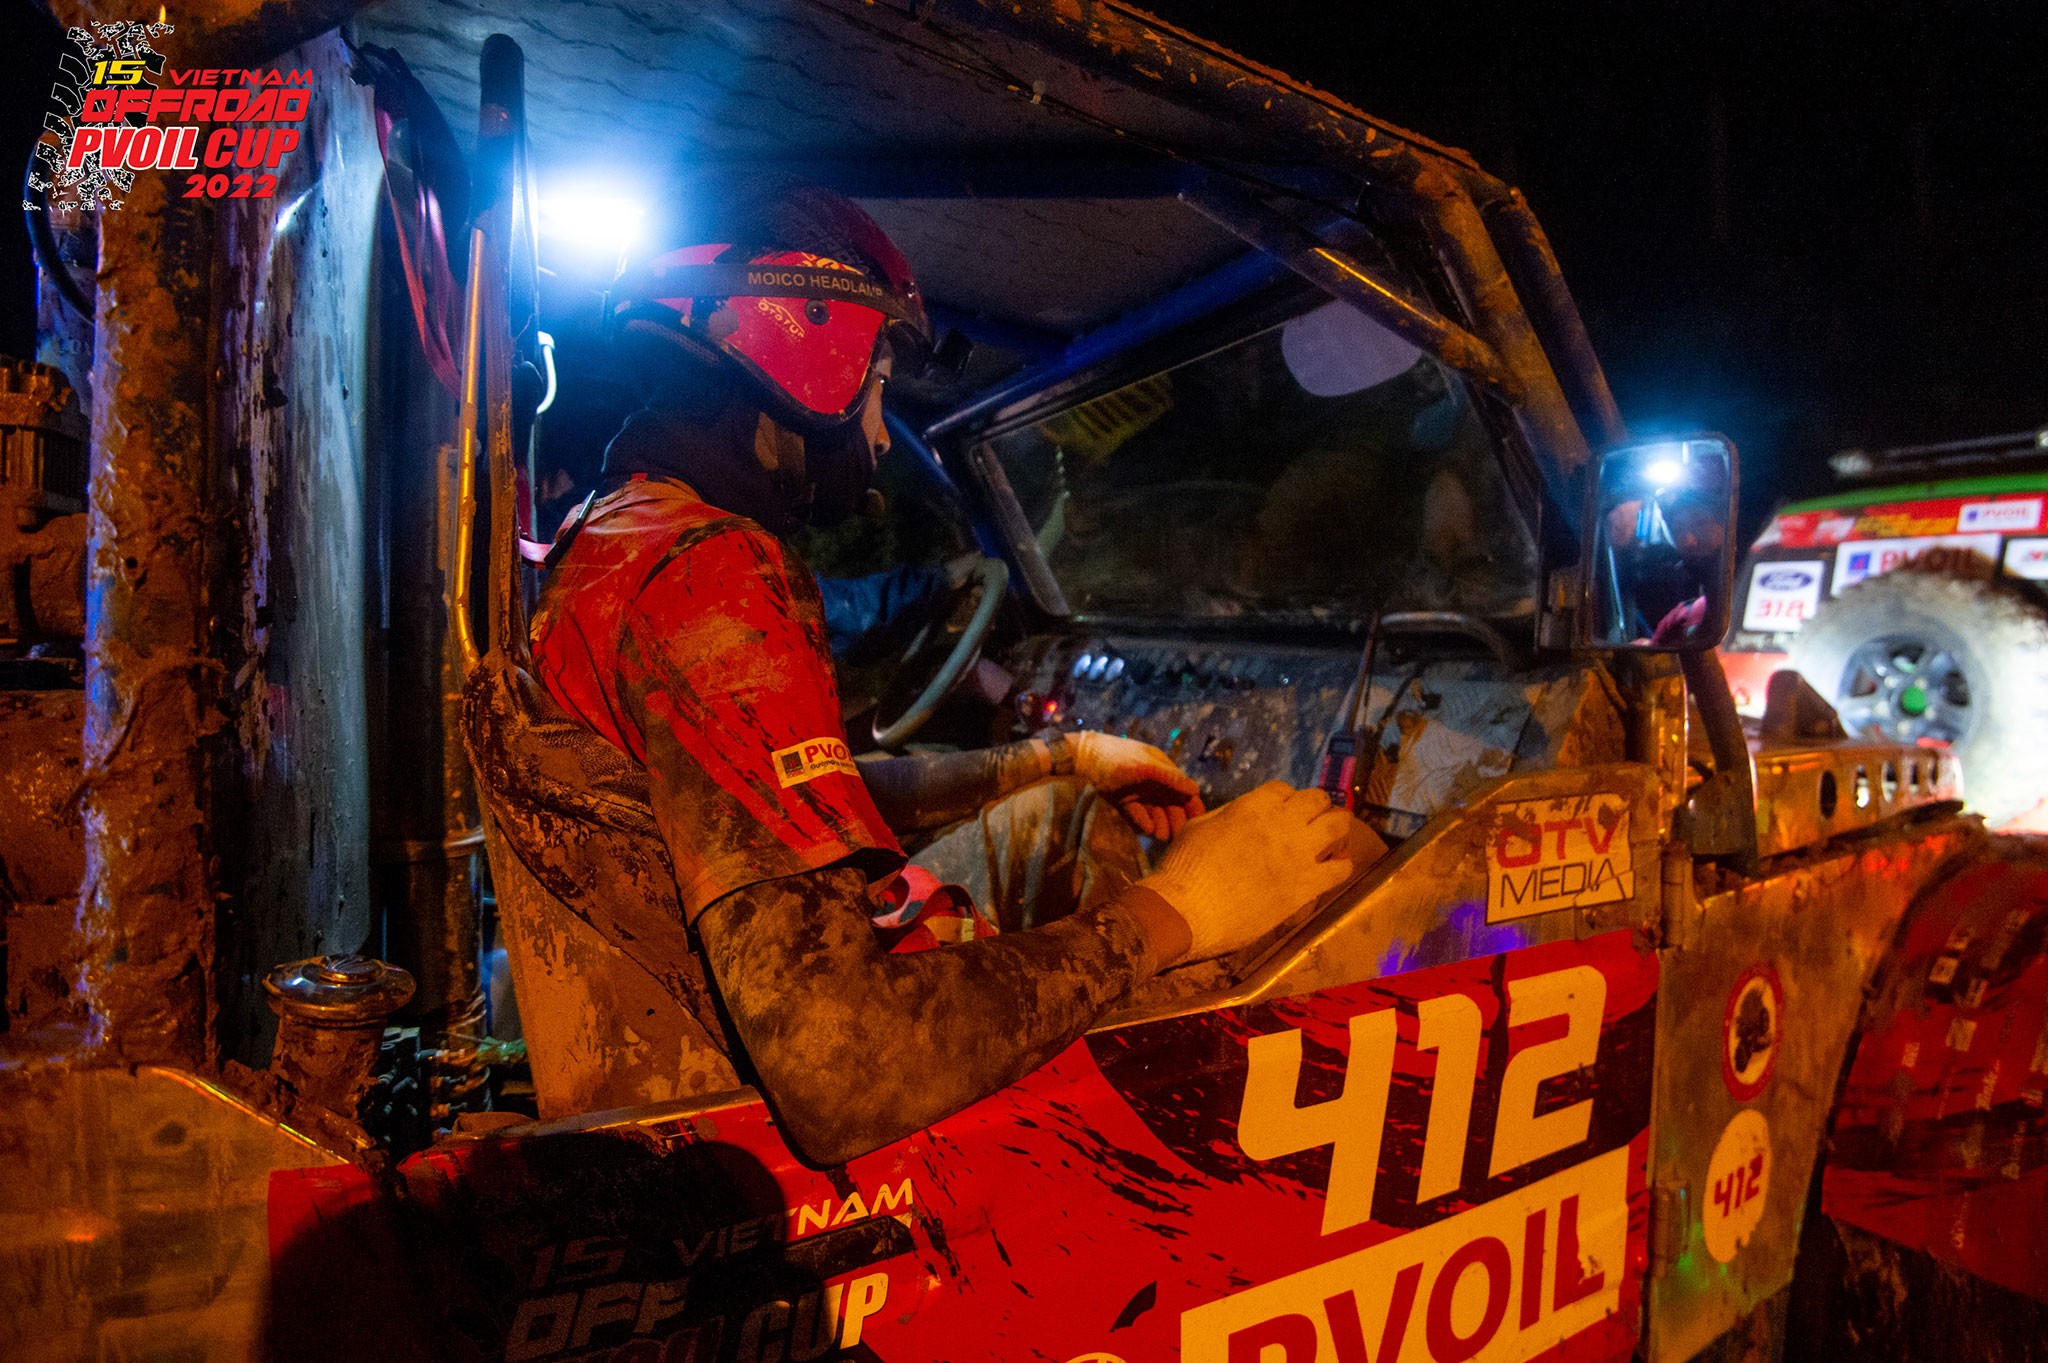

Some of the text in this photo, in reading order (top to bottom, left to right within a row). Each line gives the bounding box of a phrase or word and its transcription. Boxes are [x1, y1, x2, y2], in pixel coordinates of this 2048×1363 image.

[748, 271, 883, 298] MOICO HEADLAMP
[1500, 858, 1627, 908] MEDIA
[1237, 965, 1607, 1236] 412
[1714, 1153, 1763, 1218] 412
